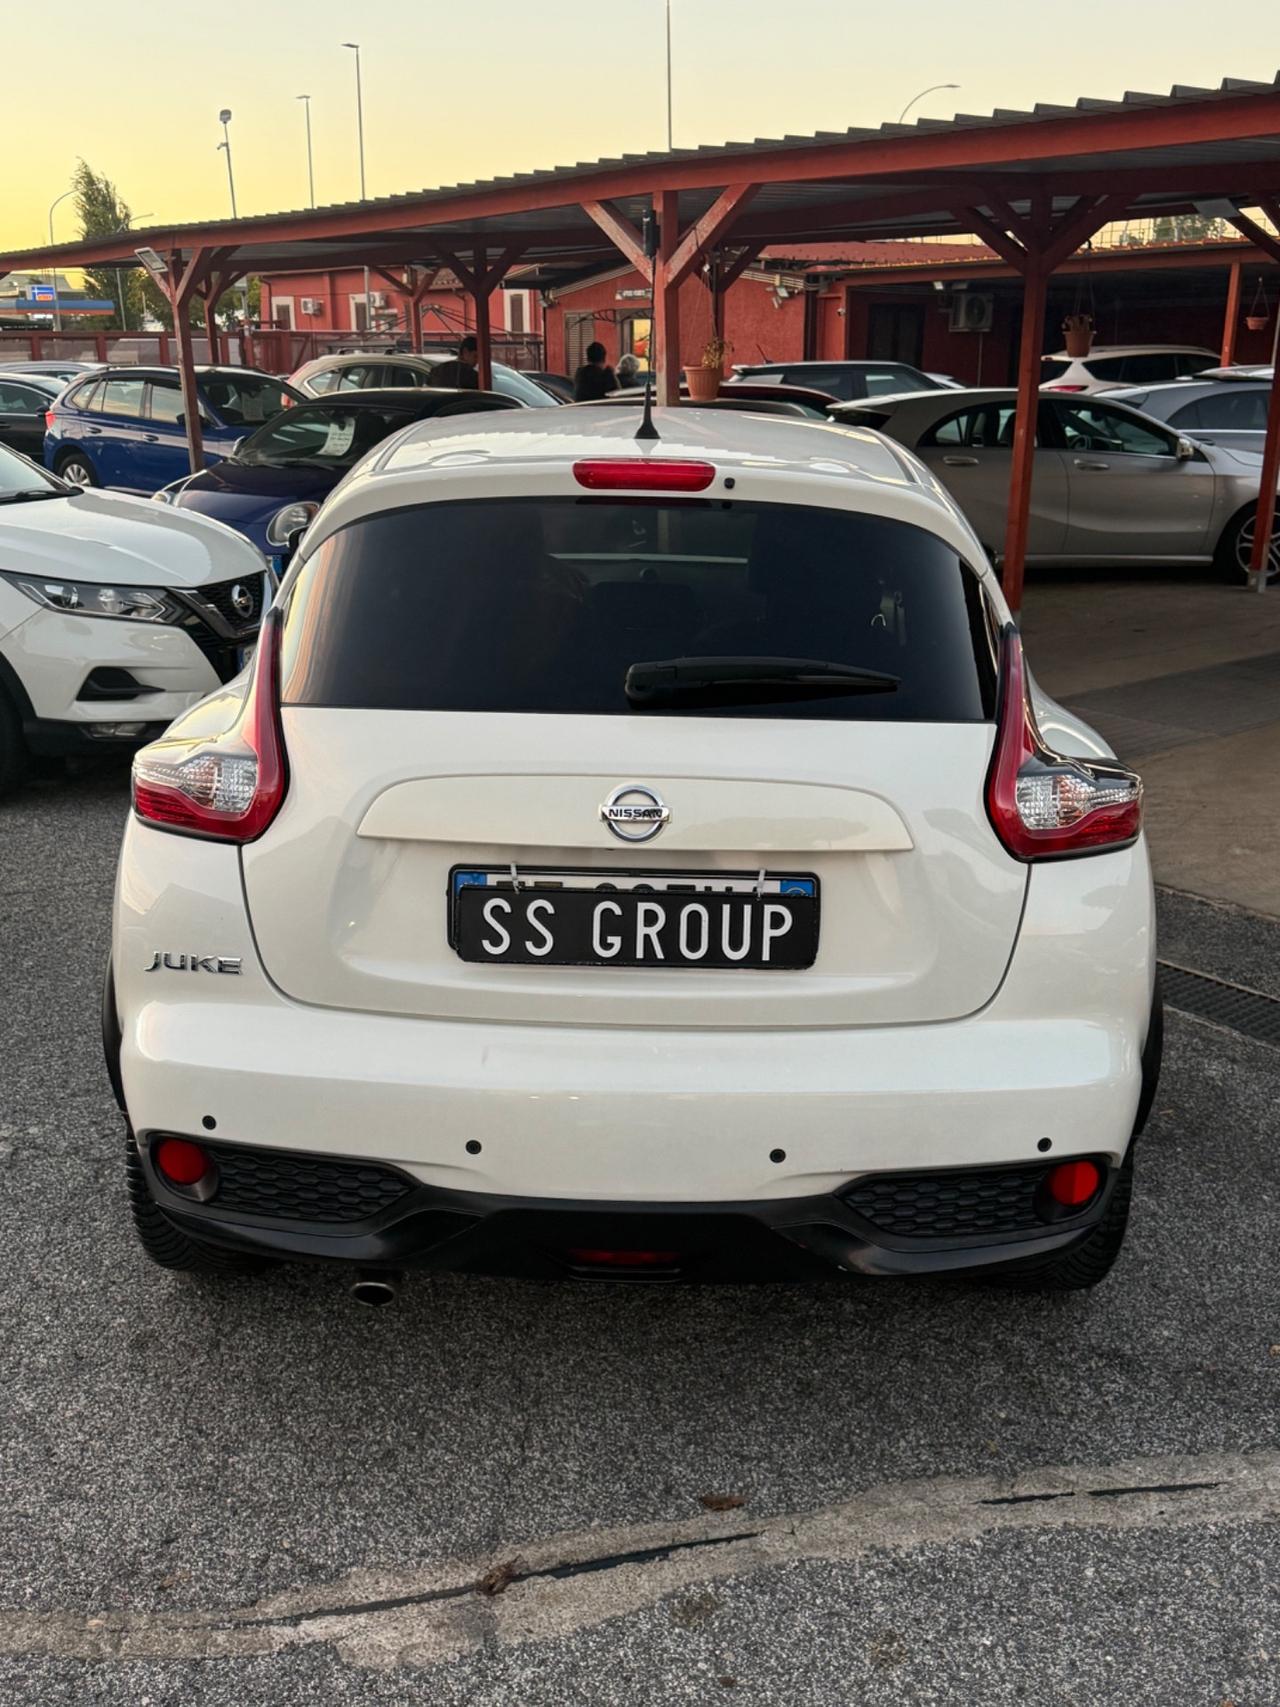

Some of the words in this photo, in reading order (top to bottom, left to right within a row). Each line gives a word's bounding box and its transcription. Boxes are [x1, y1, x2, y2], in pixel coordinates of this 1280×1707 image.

[608, 807, 663, 819] NISSAN
[592, 900, 793, 961] GROUP
[143, 951, 243, 975] JUKE
